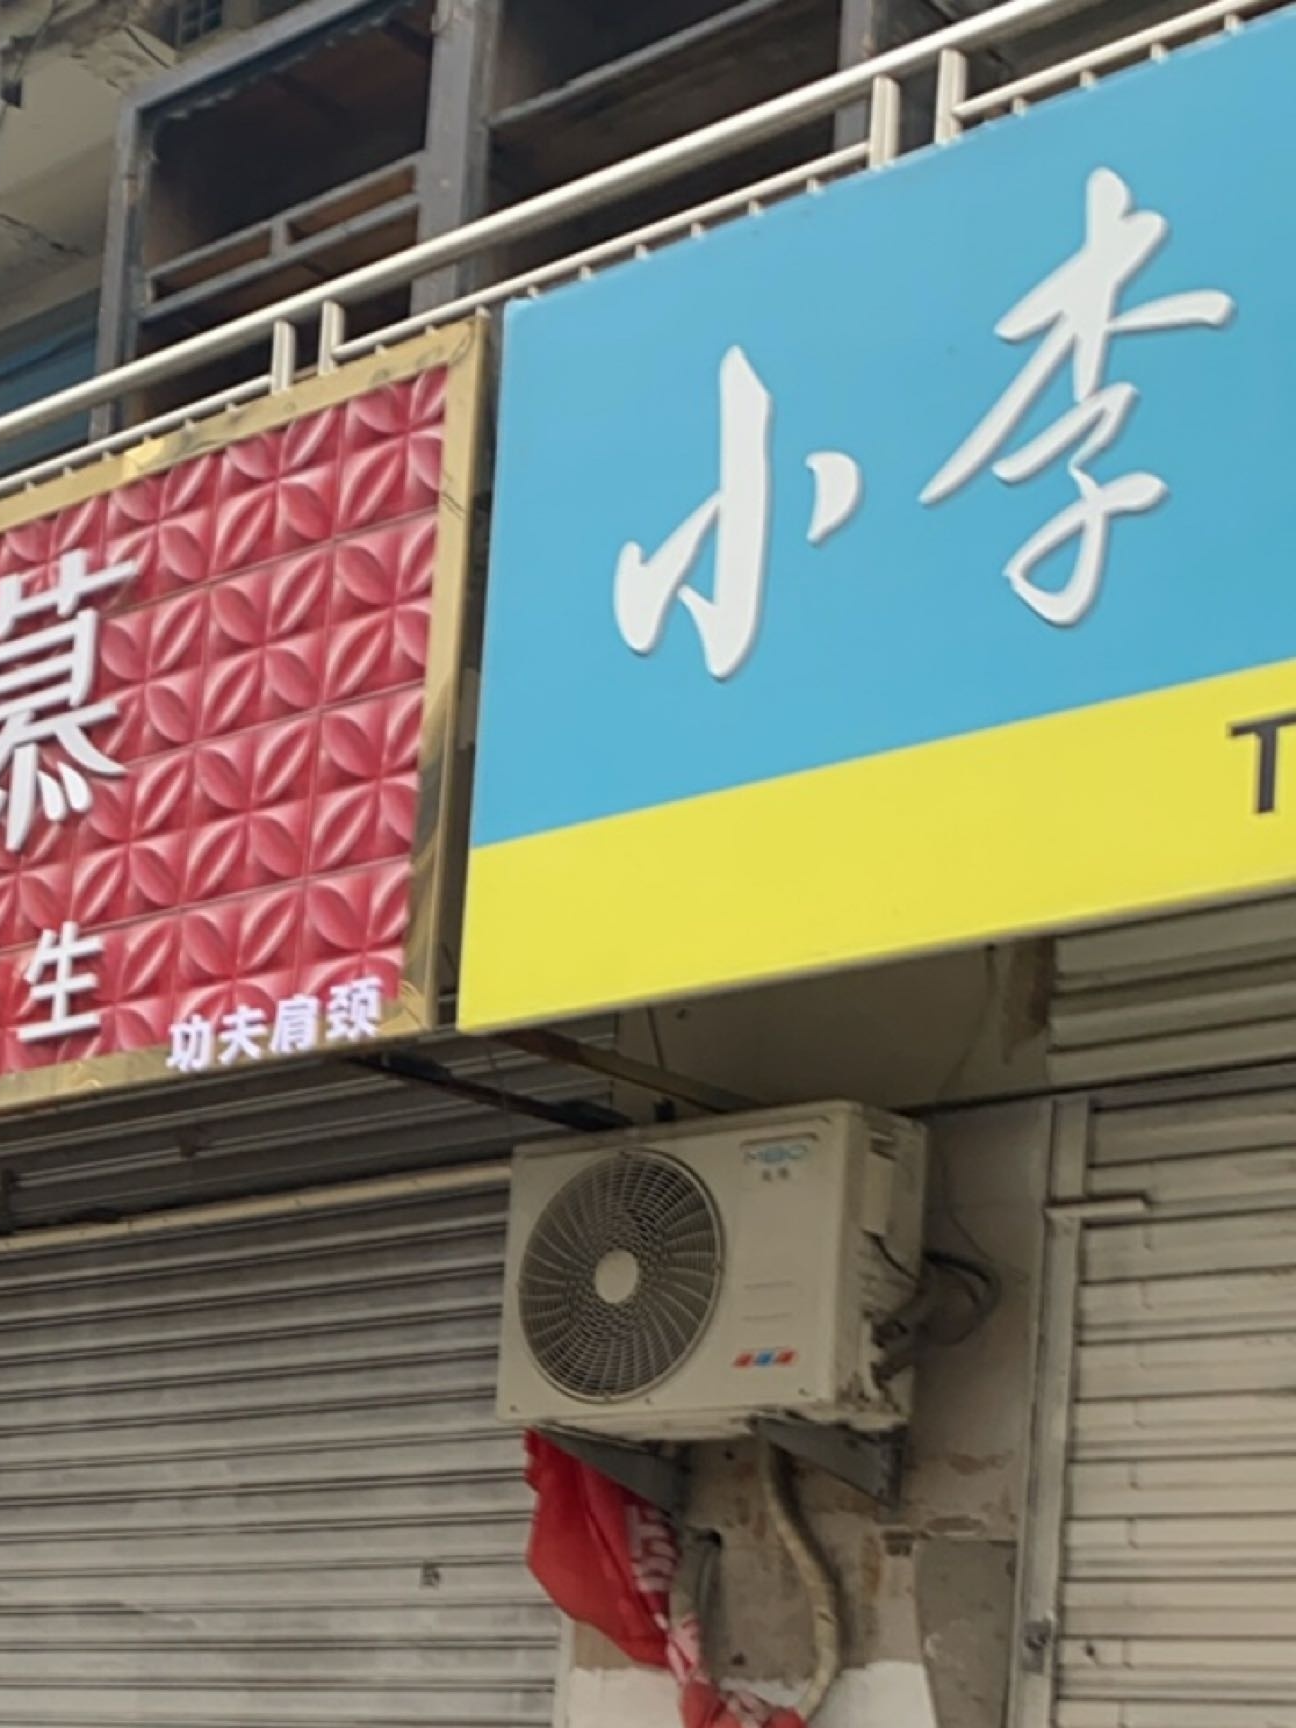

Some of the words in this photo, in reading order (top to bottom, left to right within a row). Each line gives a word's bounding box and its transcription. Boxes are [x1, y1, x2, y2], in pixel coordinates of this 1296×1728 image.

[612, 168, 1238, 683] 小李
[165, 974, 385, 1073] 功夫肩颈
